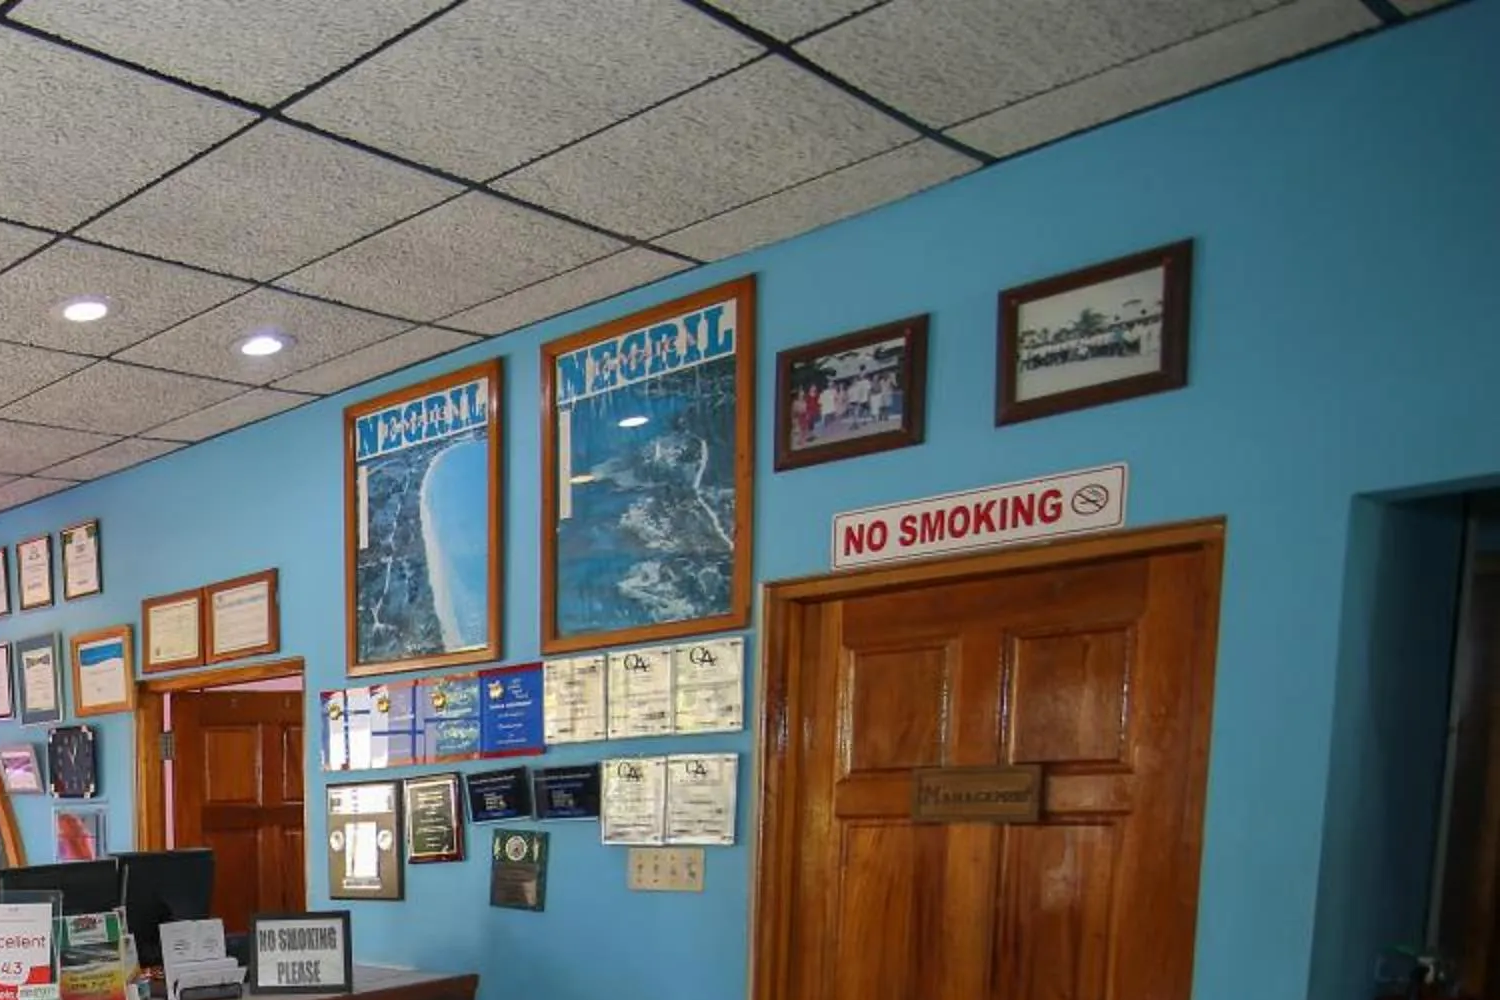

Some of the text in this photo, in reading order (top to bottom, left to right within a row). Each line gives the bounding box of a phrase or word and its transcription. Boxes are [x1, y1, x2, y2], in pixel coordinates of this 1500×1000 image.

[558, 305, 734, 397] NEGRIL
[358, 383, 486, 456] NEGRIL
[843, 489, 1063, 556] NO SMOKING
[259, 926, 337, 952] NO SMOKING
[277, 960, 321, 984] PLEASE
